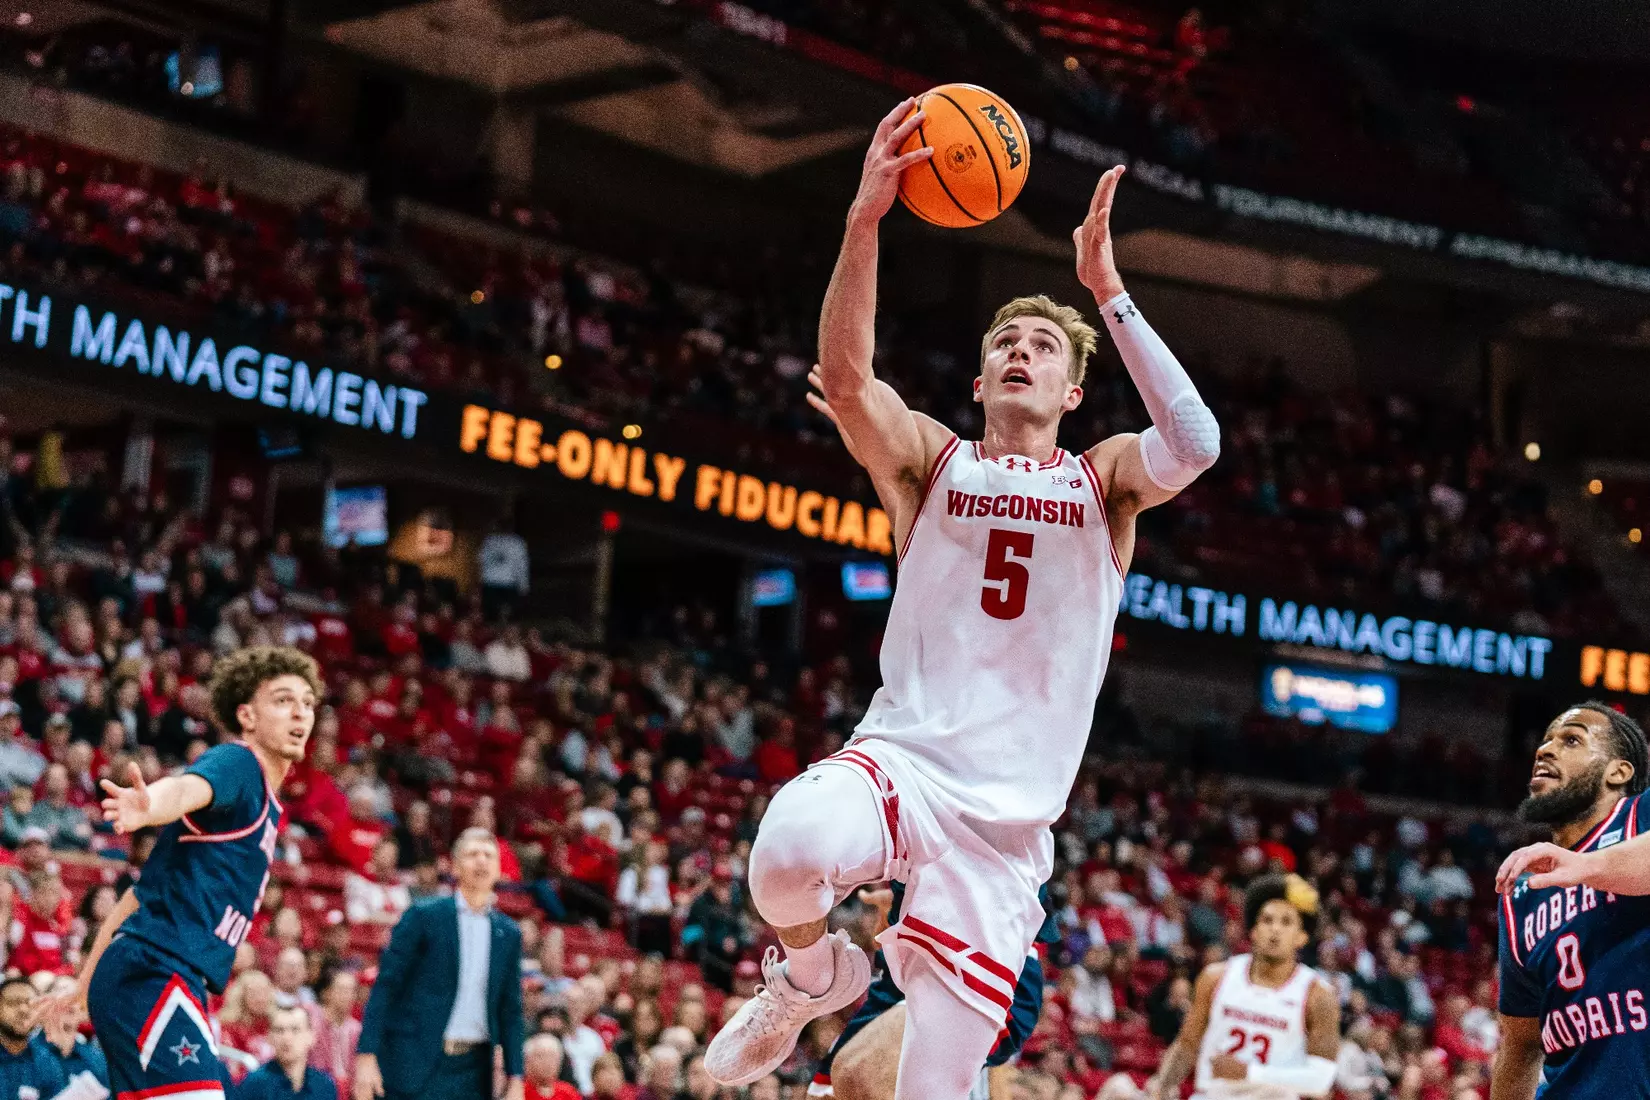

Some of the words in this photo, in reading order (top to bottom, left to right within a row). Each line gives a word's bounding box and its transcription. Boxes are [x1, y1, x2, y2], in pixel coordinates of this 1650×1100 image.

[979, 103, 1022, 171] NCAA
[70, 304, 428, 438] MANAGEMENT
[460, 404, 686, 501] FEE-ONLY
[947, 489, 1084, 528] WISCONSIN
[981, 528, 1035, 620] 5
[1258, 597, 1553, 680] MANAGEMENT
[1555, 931, 1587, 992] 0
[1227, 1028, 1271, 1065] 23
[1541, 989, 1649, 1055] MORRIS
